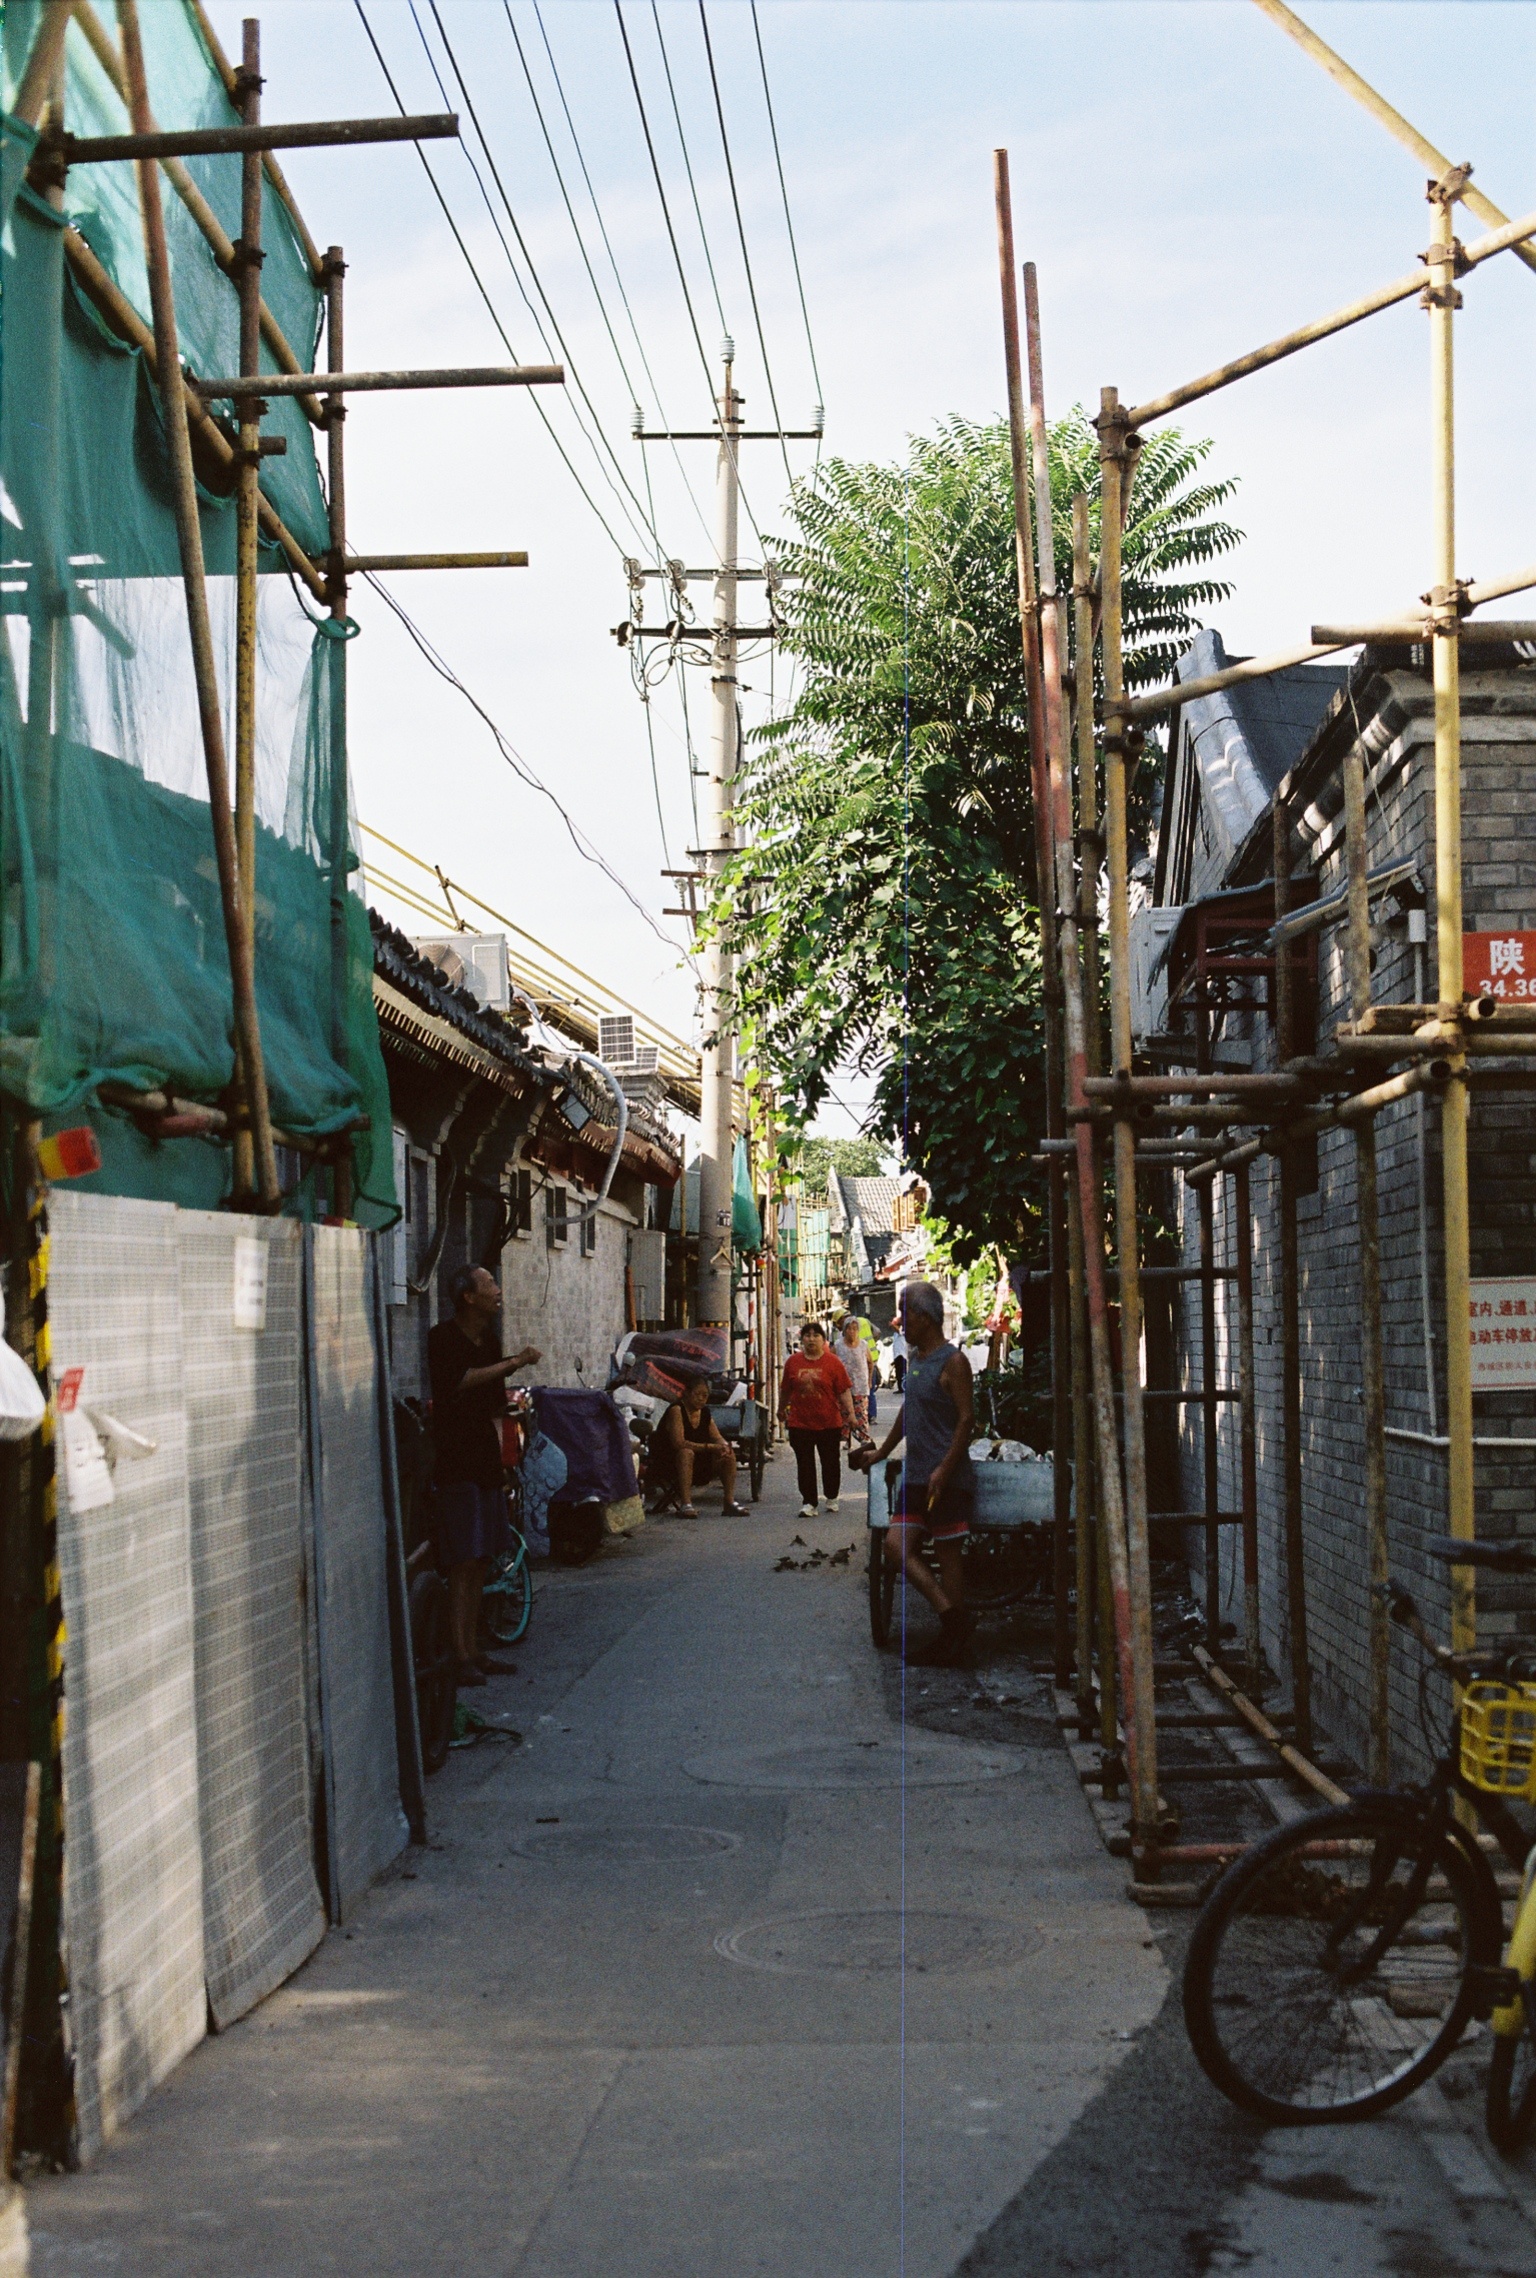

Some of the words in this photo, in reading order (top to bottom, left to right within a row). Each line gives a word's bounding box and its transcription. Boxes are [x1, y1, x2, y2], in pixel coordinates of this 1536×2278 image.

[1489, 938, 1525, 976] 陕
[1469, 1327, 1536, 1345] 电动车停放
